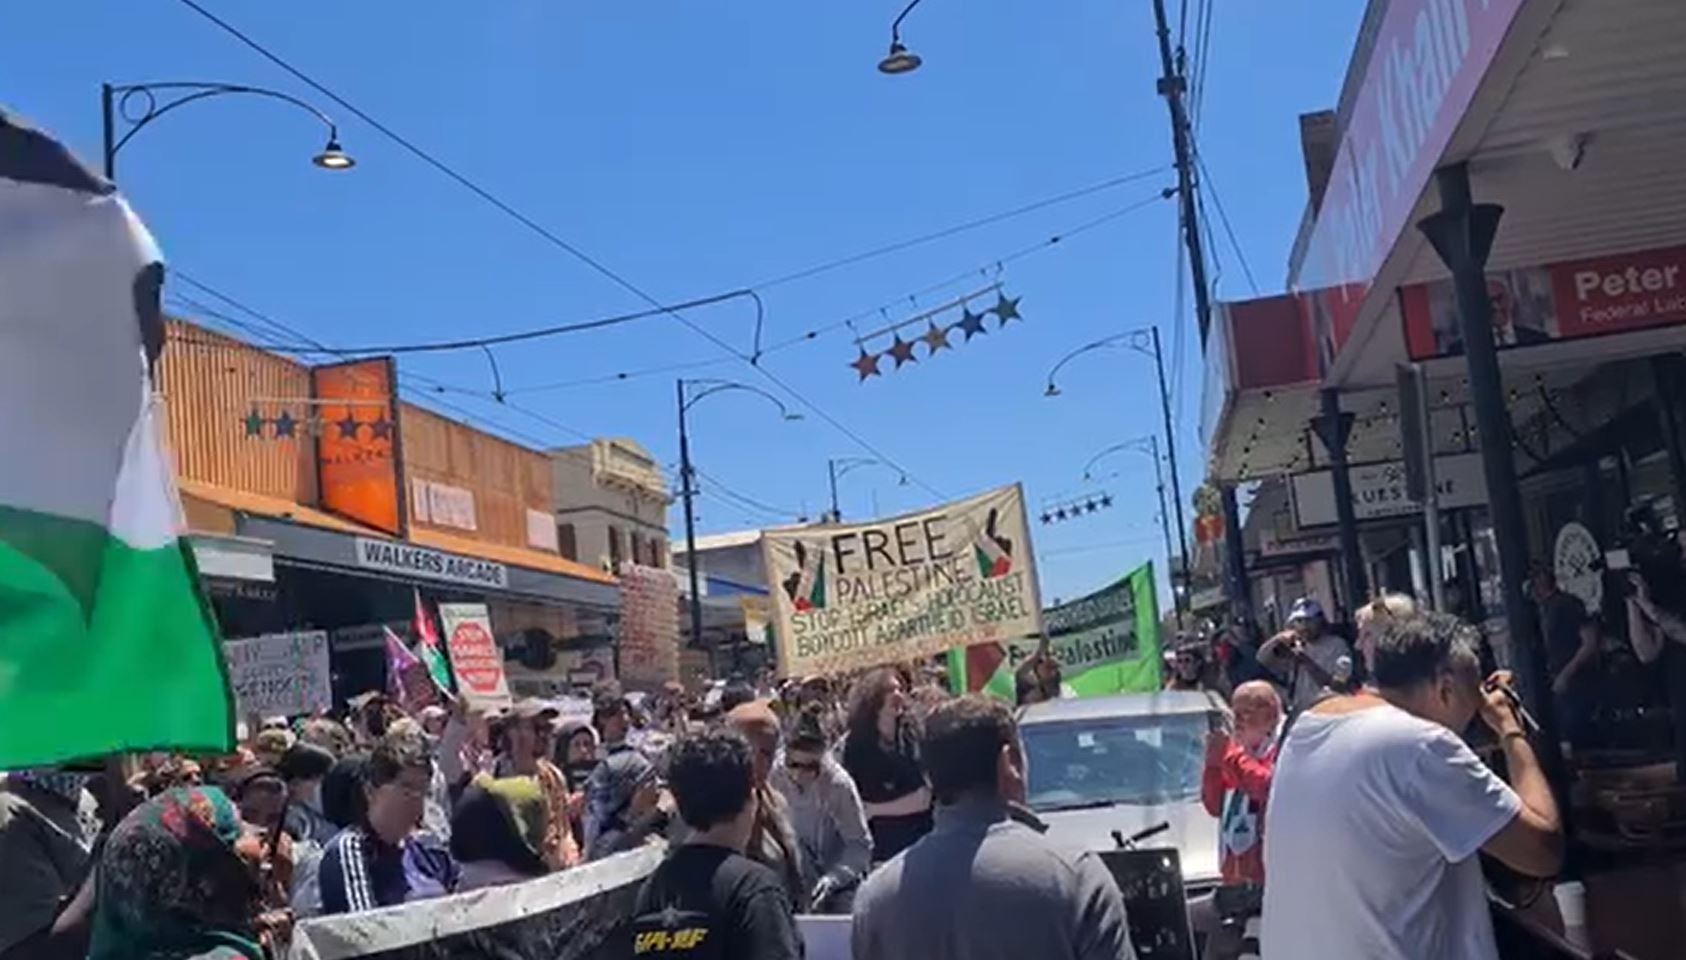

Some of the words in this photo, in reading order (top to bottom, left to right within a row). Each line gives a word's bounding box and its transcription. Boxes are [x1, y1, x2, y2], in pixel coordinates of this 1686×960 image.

[1575, 264, 1679, 301] Peter
[1580, 300, 1649, 323] Federal
[364, 541, 443, 573] WALKERS
[446, 558, 501, 585] ARCADE
[831, 514, 953, 575] FREE
[835, 552, 973, 605] PALESTINE
[790, 607, 840, 635] STOP
[797, 627, 868, 658] BOYCOTT
[875, 607, 966, 646] APARTHEID
[970, 595, 1031, 625] ISRAEL
